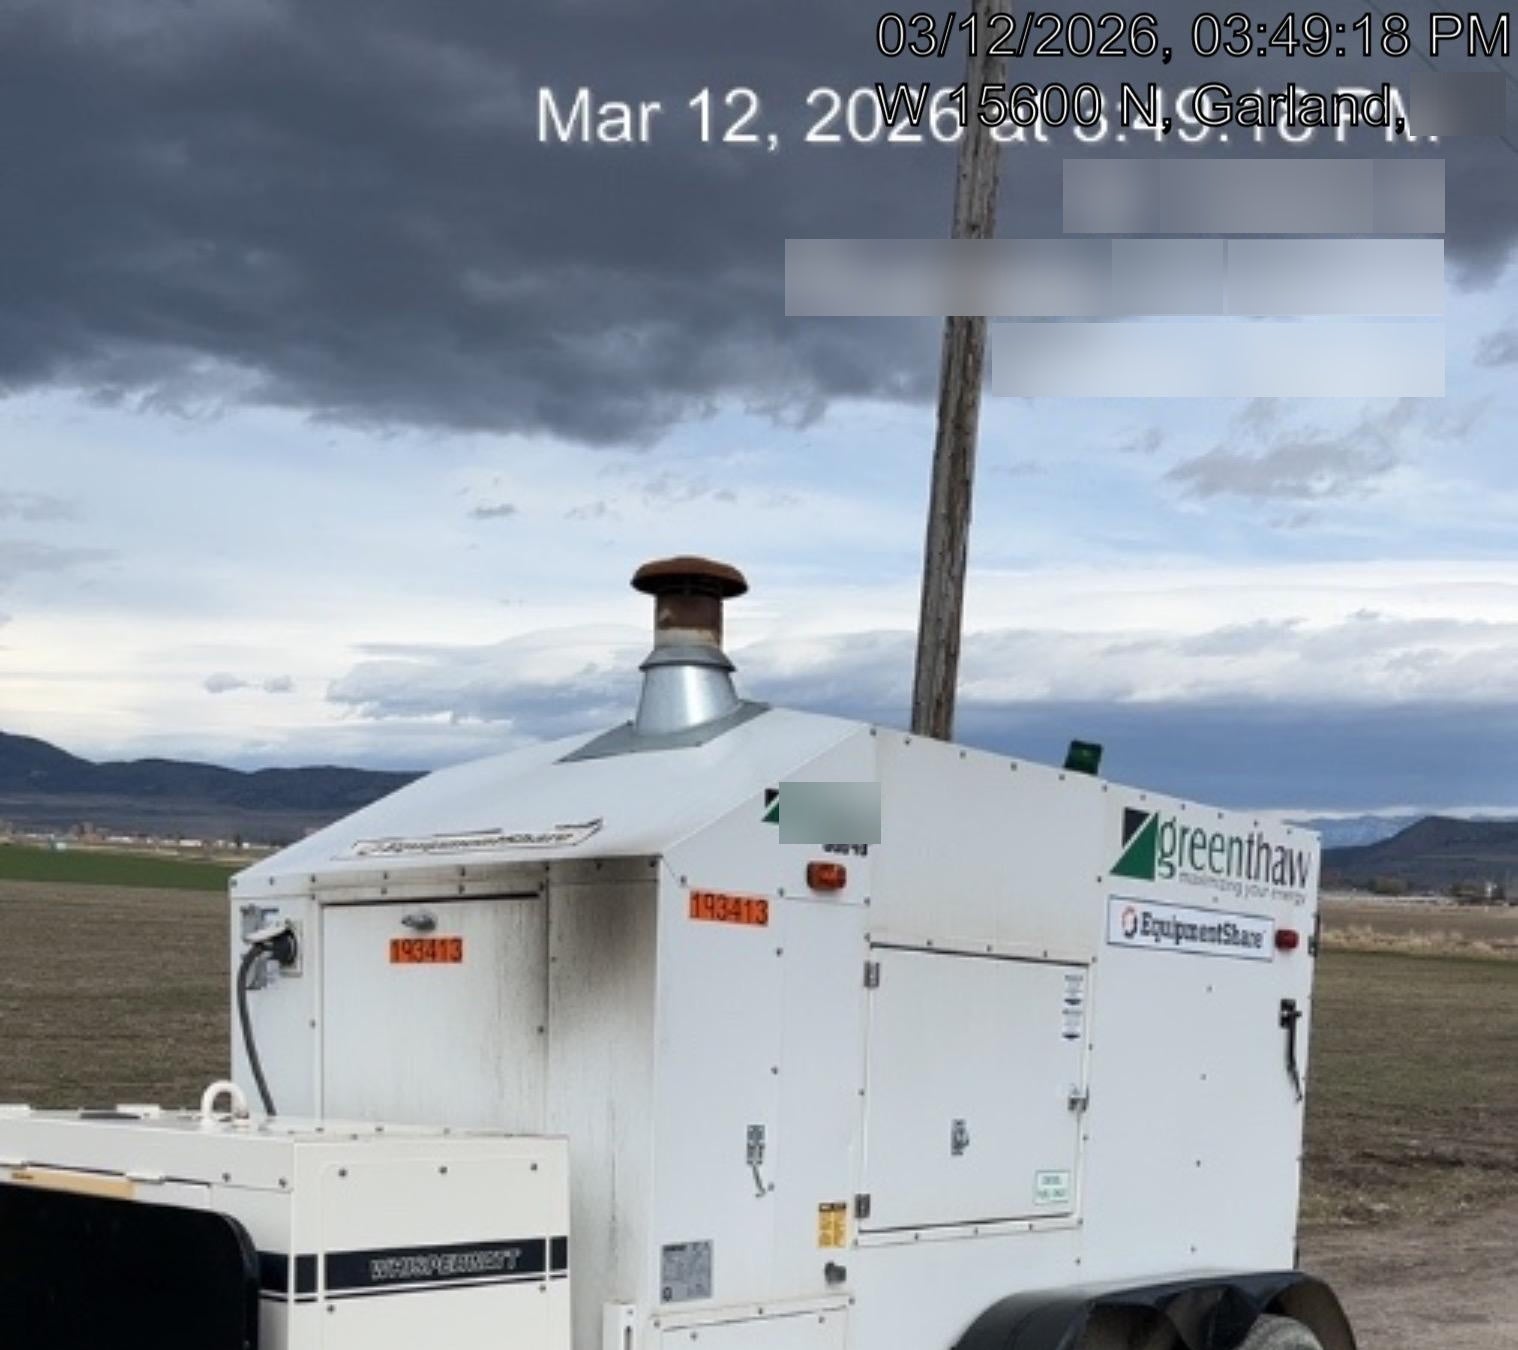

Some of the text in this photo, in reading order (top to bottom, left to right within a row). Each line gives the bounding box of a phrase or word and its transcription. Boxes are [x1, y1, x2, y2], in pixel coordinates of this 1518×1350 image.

[1158, 815, 1312, 889] greenthaw
[691, 890, 769, 927] 193413
[1140, 911, 1264, 949] EquipmentShare
[390, 938, 463, 963] 193413
